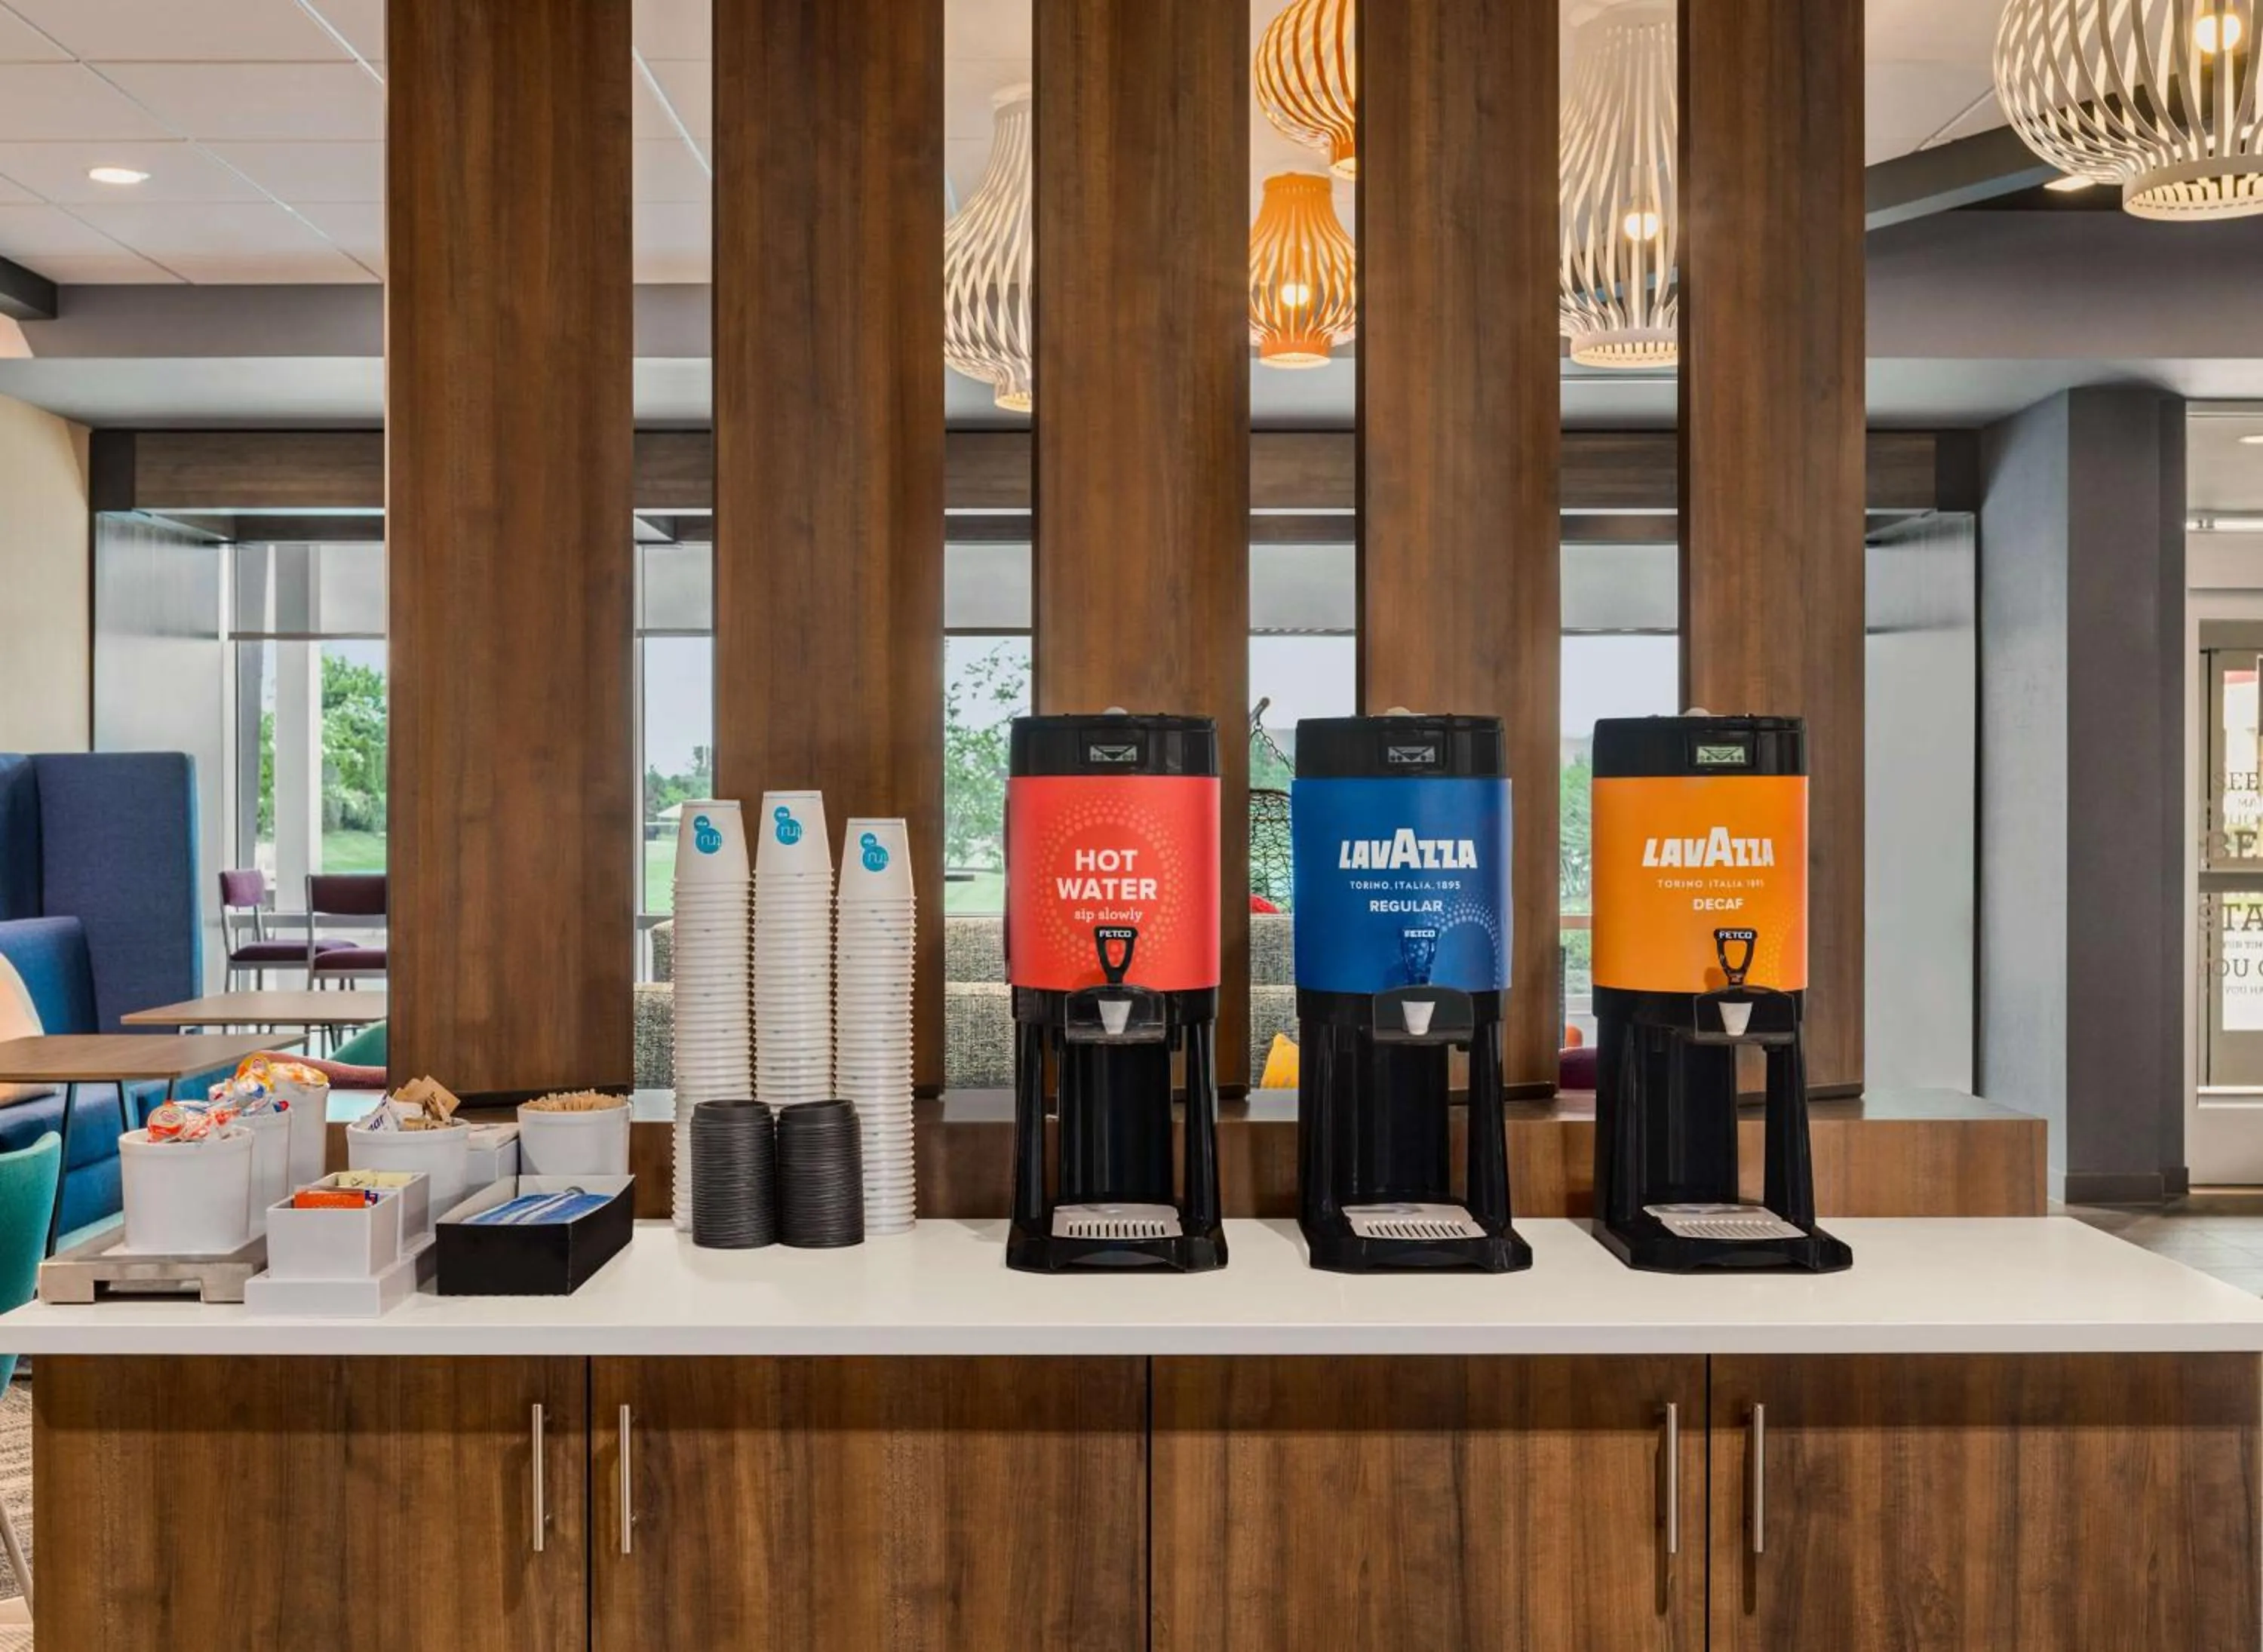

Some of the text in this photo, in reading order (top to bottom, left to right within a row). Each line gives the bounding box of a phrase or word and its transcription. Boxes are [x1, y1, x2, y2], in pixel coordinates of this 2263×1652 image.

[1338, 828, 1478, 869] LAVAZZA
[1641, 826, 1775, 867] LAVAZZA
[1075, 849, 1138, 871] HOT
[1056, 877, 1157, 900] WATER
[1437, 880, 1461, 889] 1895
[1369, 900, 1443, 913] REGULAR
[1693, 898, 1744, 910] DECAF
[1074, 907, 1143, 923] sip slowly
[1099, 929, 1132, 938] FETCO
[1404, 929, 1436, 938] FETCO
[1718, 931, 1752, 939] FETCO
